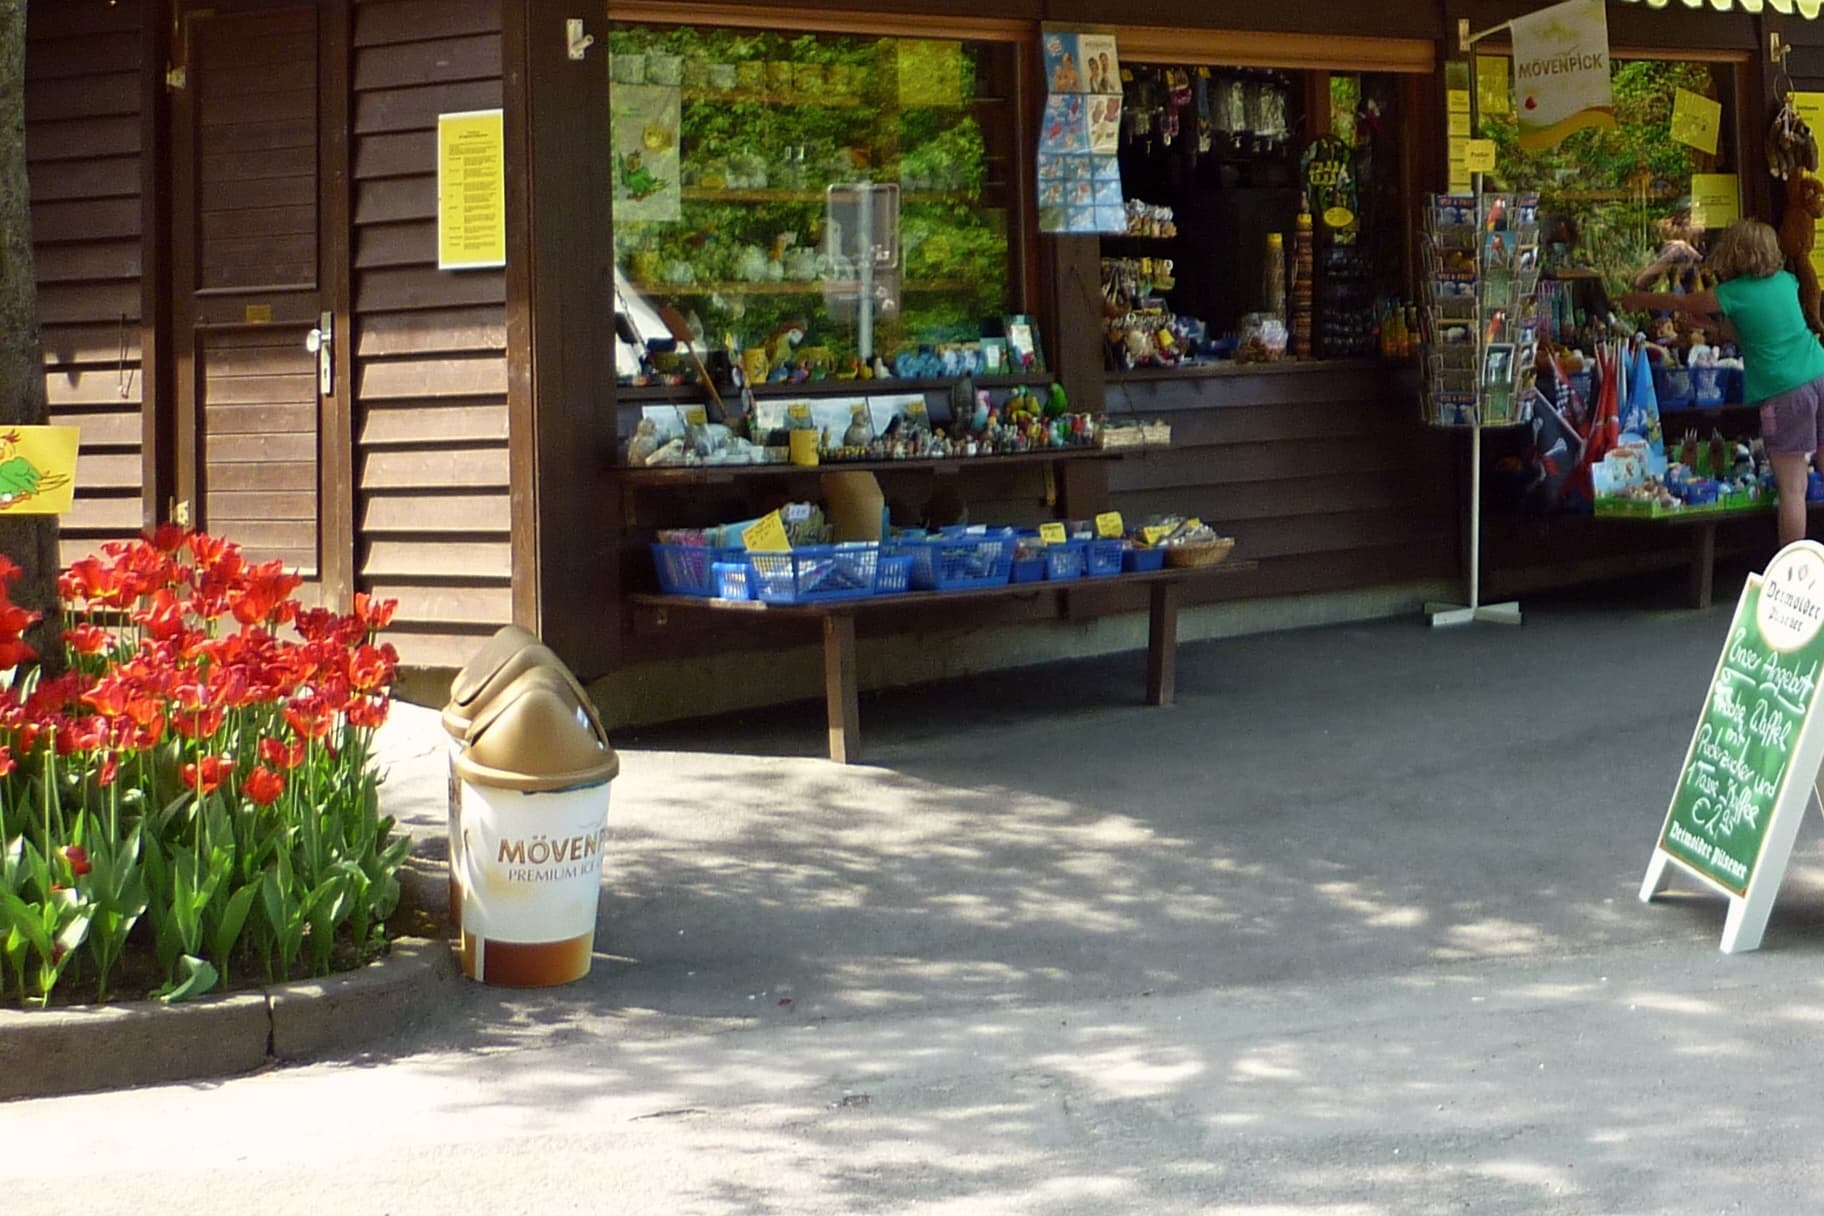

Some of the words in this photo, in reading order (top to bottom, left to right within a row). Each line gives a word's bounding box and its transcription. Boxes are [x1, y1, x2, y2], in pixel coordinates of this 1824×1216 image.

[1761, 650, 1818, 698] Angebot
[1754, 760, 1786, 798] und
[497, 827, 605, 865] MÖVENP
[1668, 820, 1713, 860] Detmolder
[1710, 845, 1748, 881] Pilsener
[508, 865, 578, 882] PREMIUM
